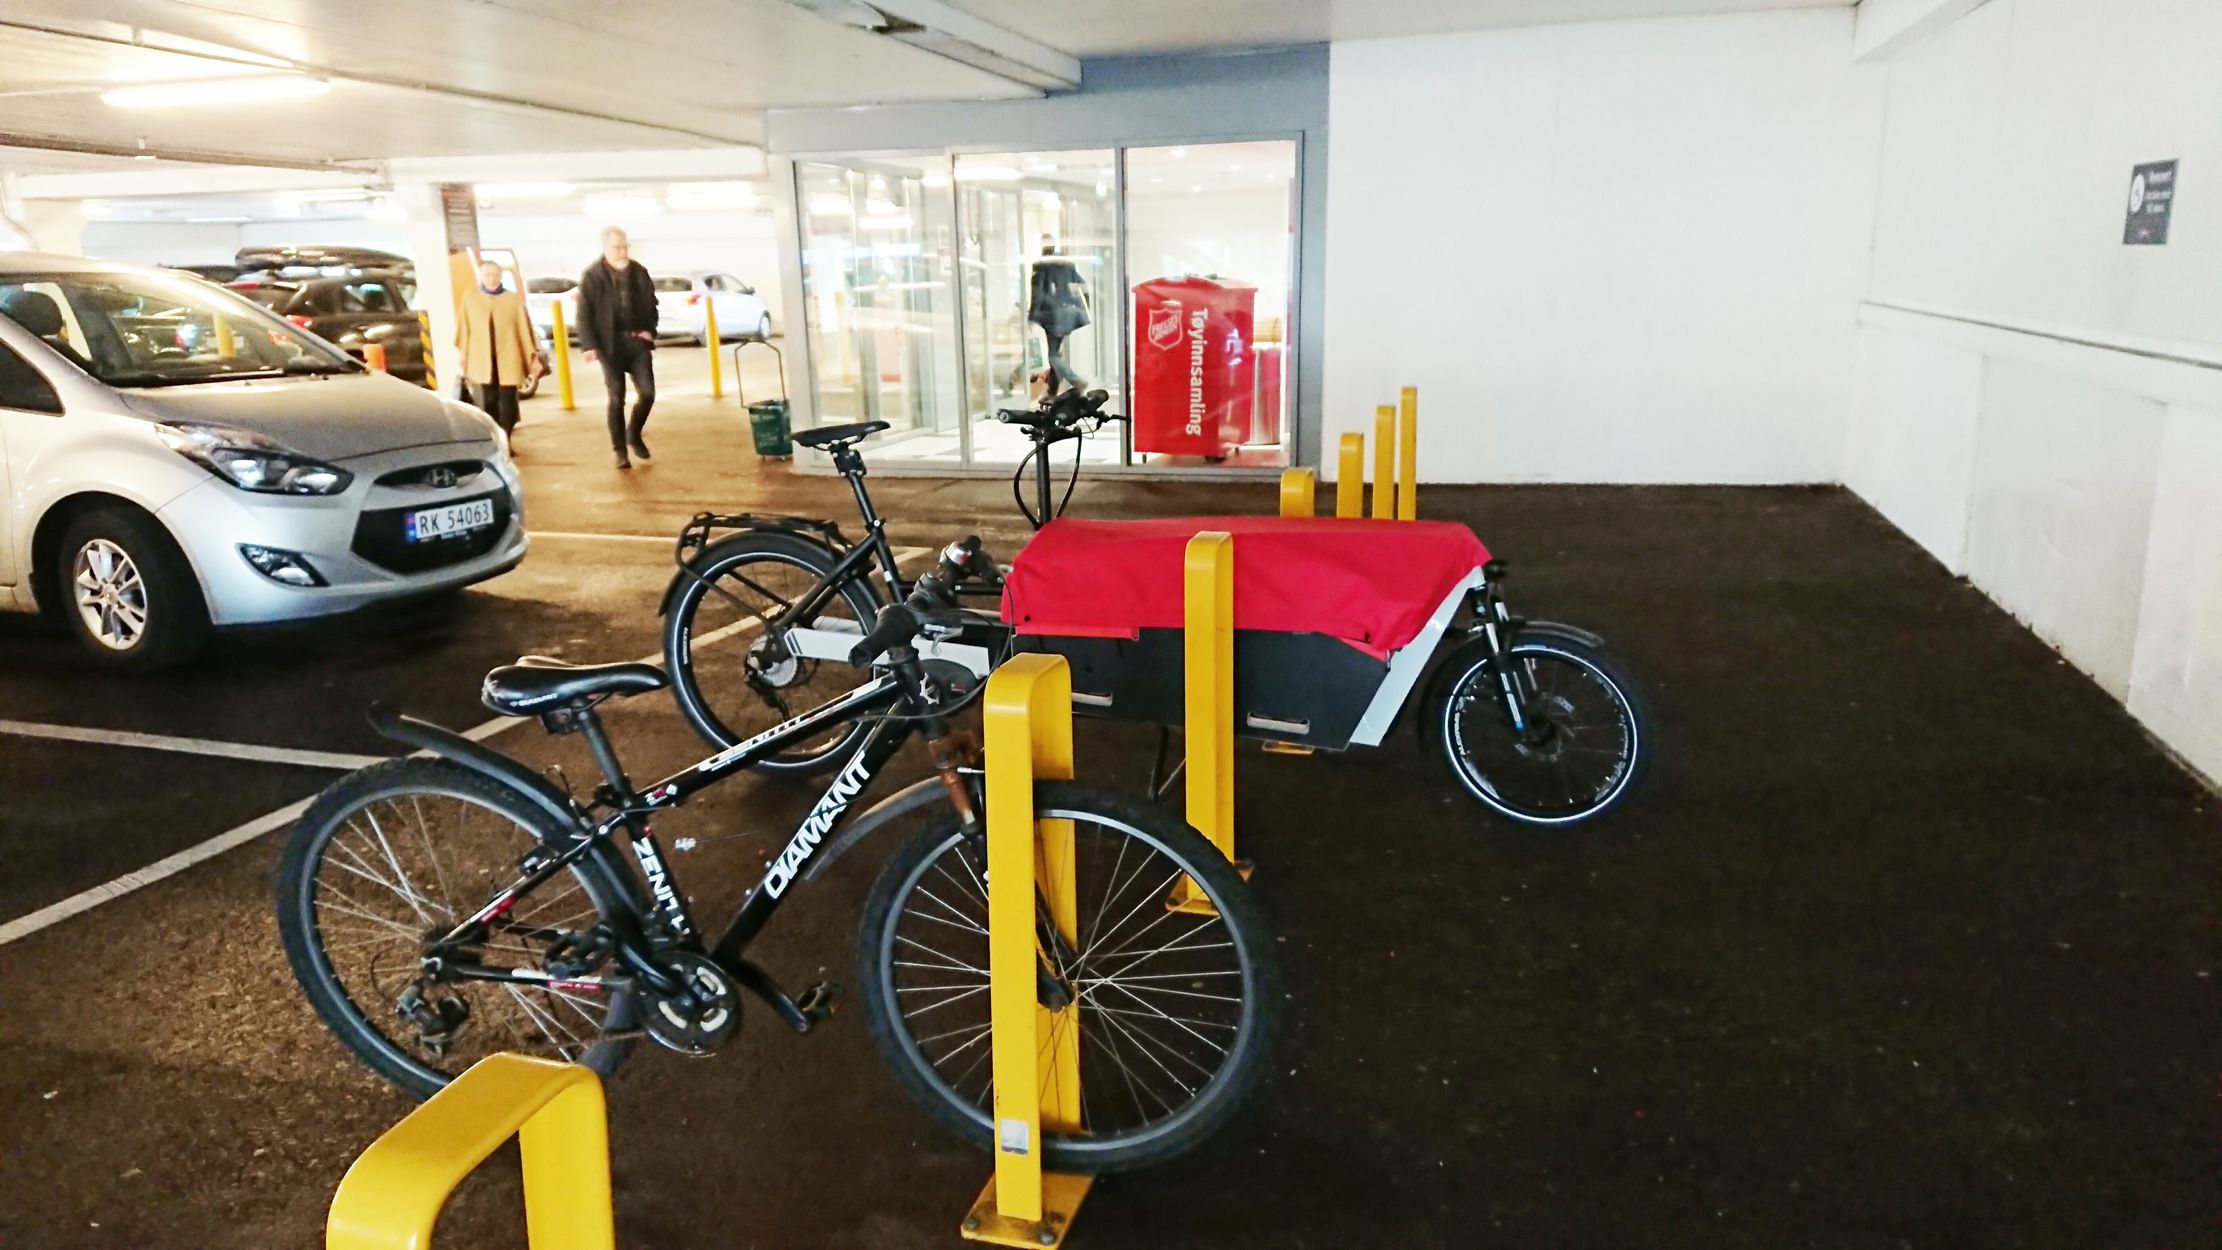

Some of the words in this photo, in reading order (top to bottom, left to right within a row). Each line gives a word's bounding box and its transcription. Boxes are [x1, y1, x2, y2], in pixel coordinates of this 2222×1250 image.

[1185, 308, 1209, 436] Tøyinnsamling
[419, 514, 440, 534] RK
[447, 503, 489, 529] 54063
[763, 750, 871, 899] DIAMANT
